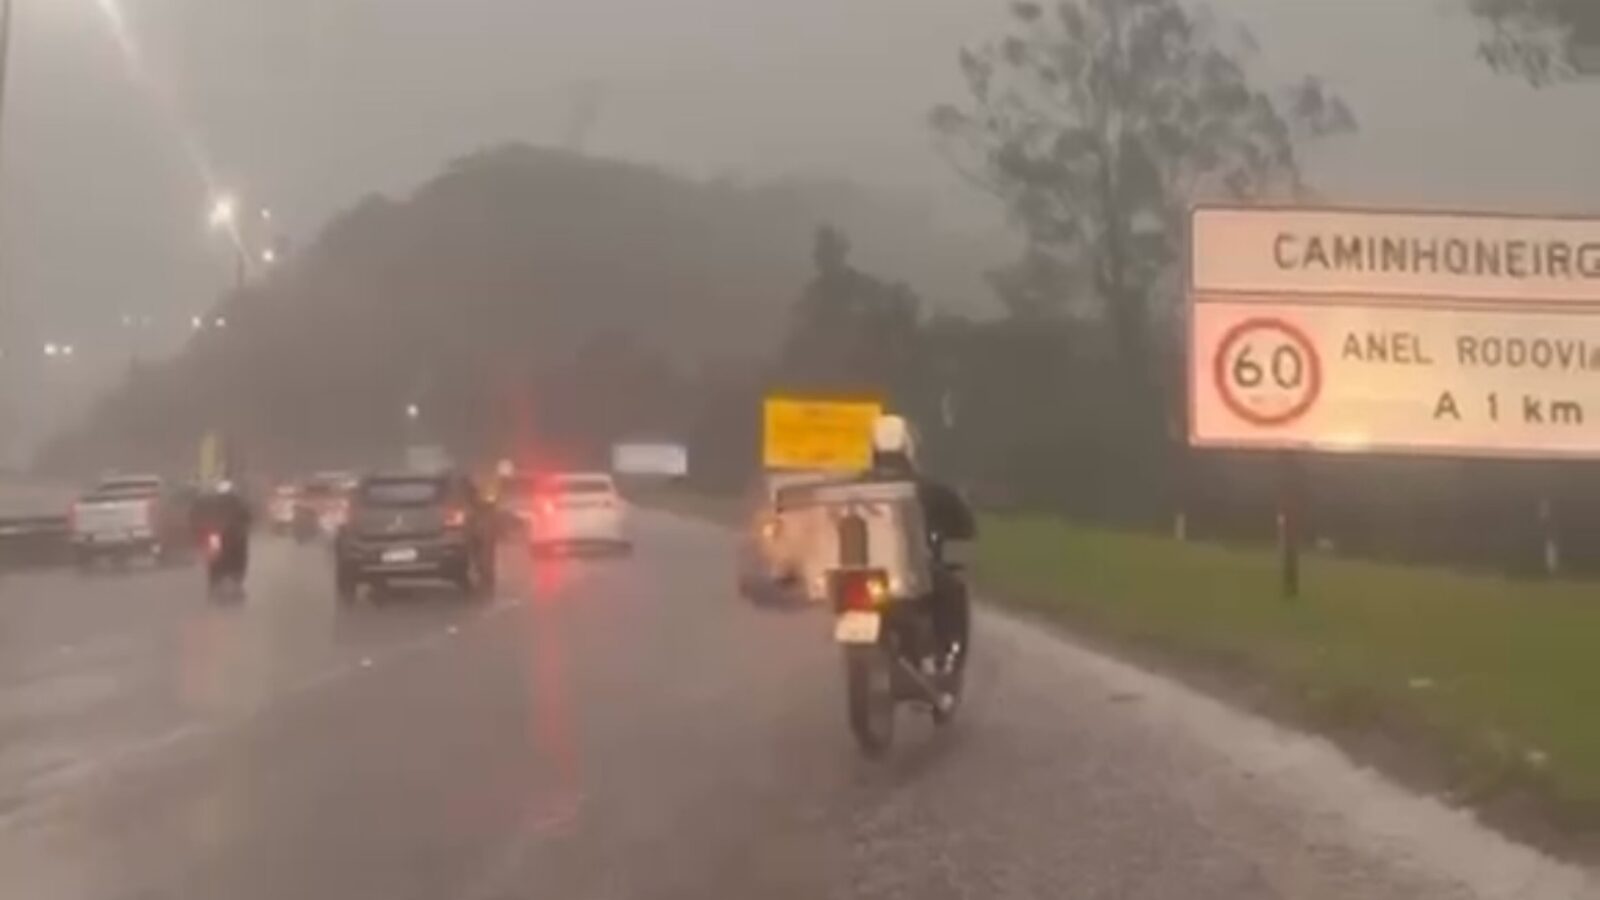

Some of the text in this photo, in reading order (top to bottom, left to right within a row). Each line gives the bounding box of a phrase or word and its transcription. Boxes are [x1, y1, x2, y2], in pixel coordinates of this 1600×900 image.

[1341, 332, 1434, 365] ANEL
[1233, 344, 1303, 389] 60
[1433, 391, 1583, 425] A 1 km
